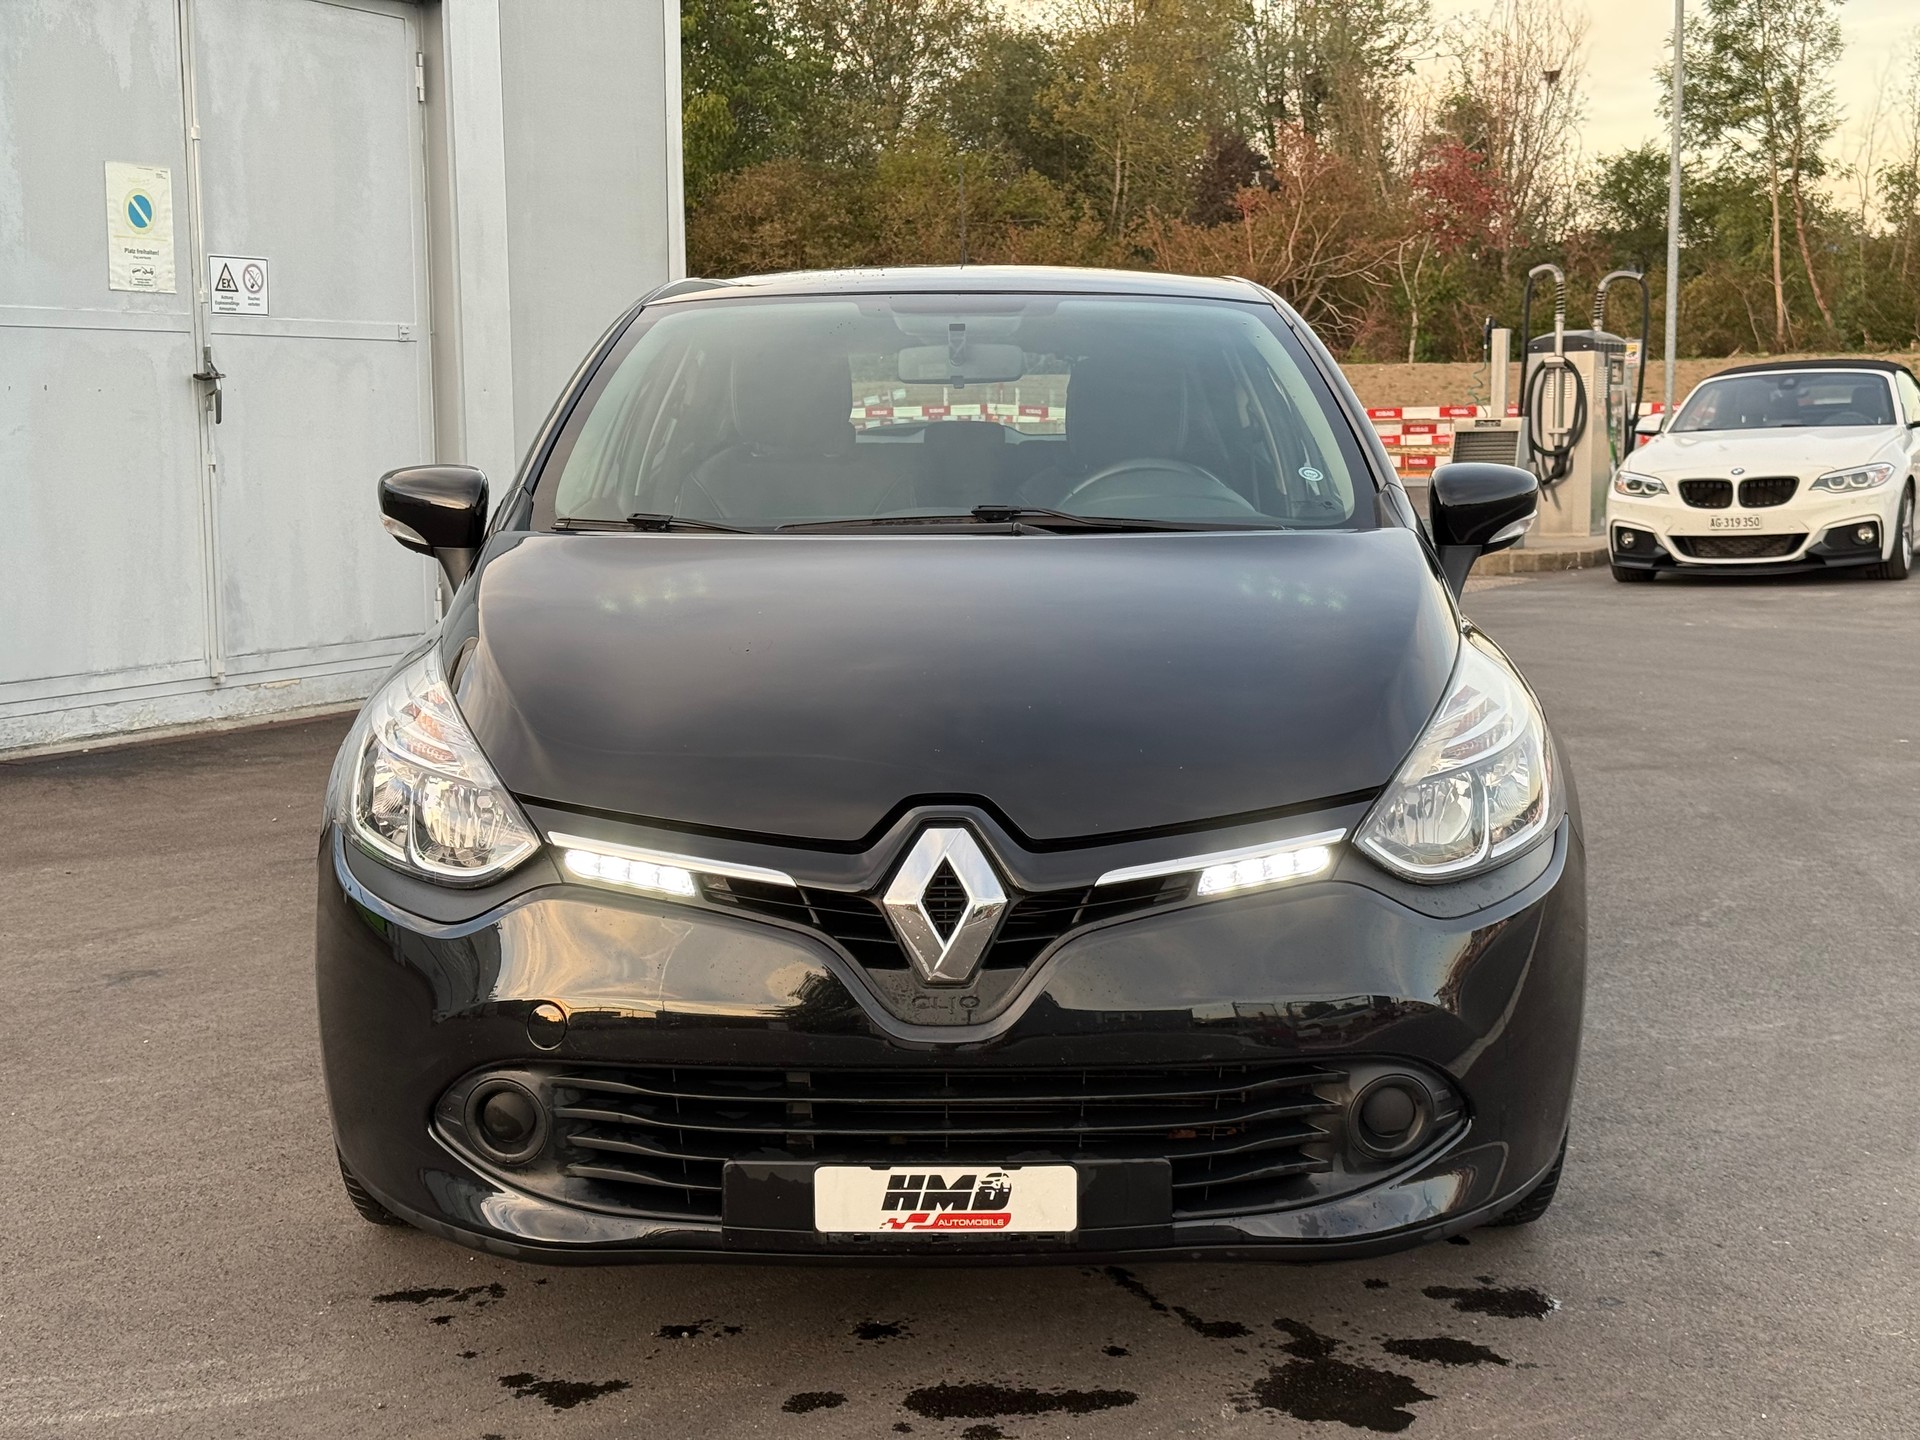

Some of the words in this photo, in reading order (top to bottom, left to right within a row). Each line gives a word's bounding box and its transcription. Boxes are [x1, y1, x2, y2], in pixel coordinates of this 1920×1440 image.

[222, 278, 232, 288] EX
[1743, 517, 1760, 527] 350
[881, 1172, 1012, 1211] HMD
[937, 1218, 1004, 1226] AUTOMOBILE
